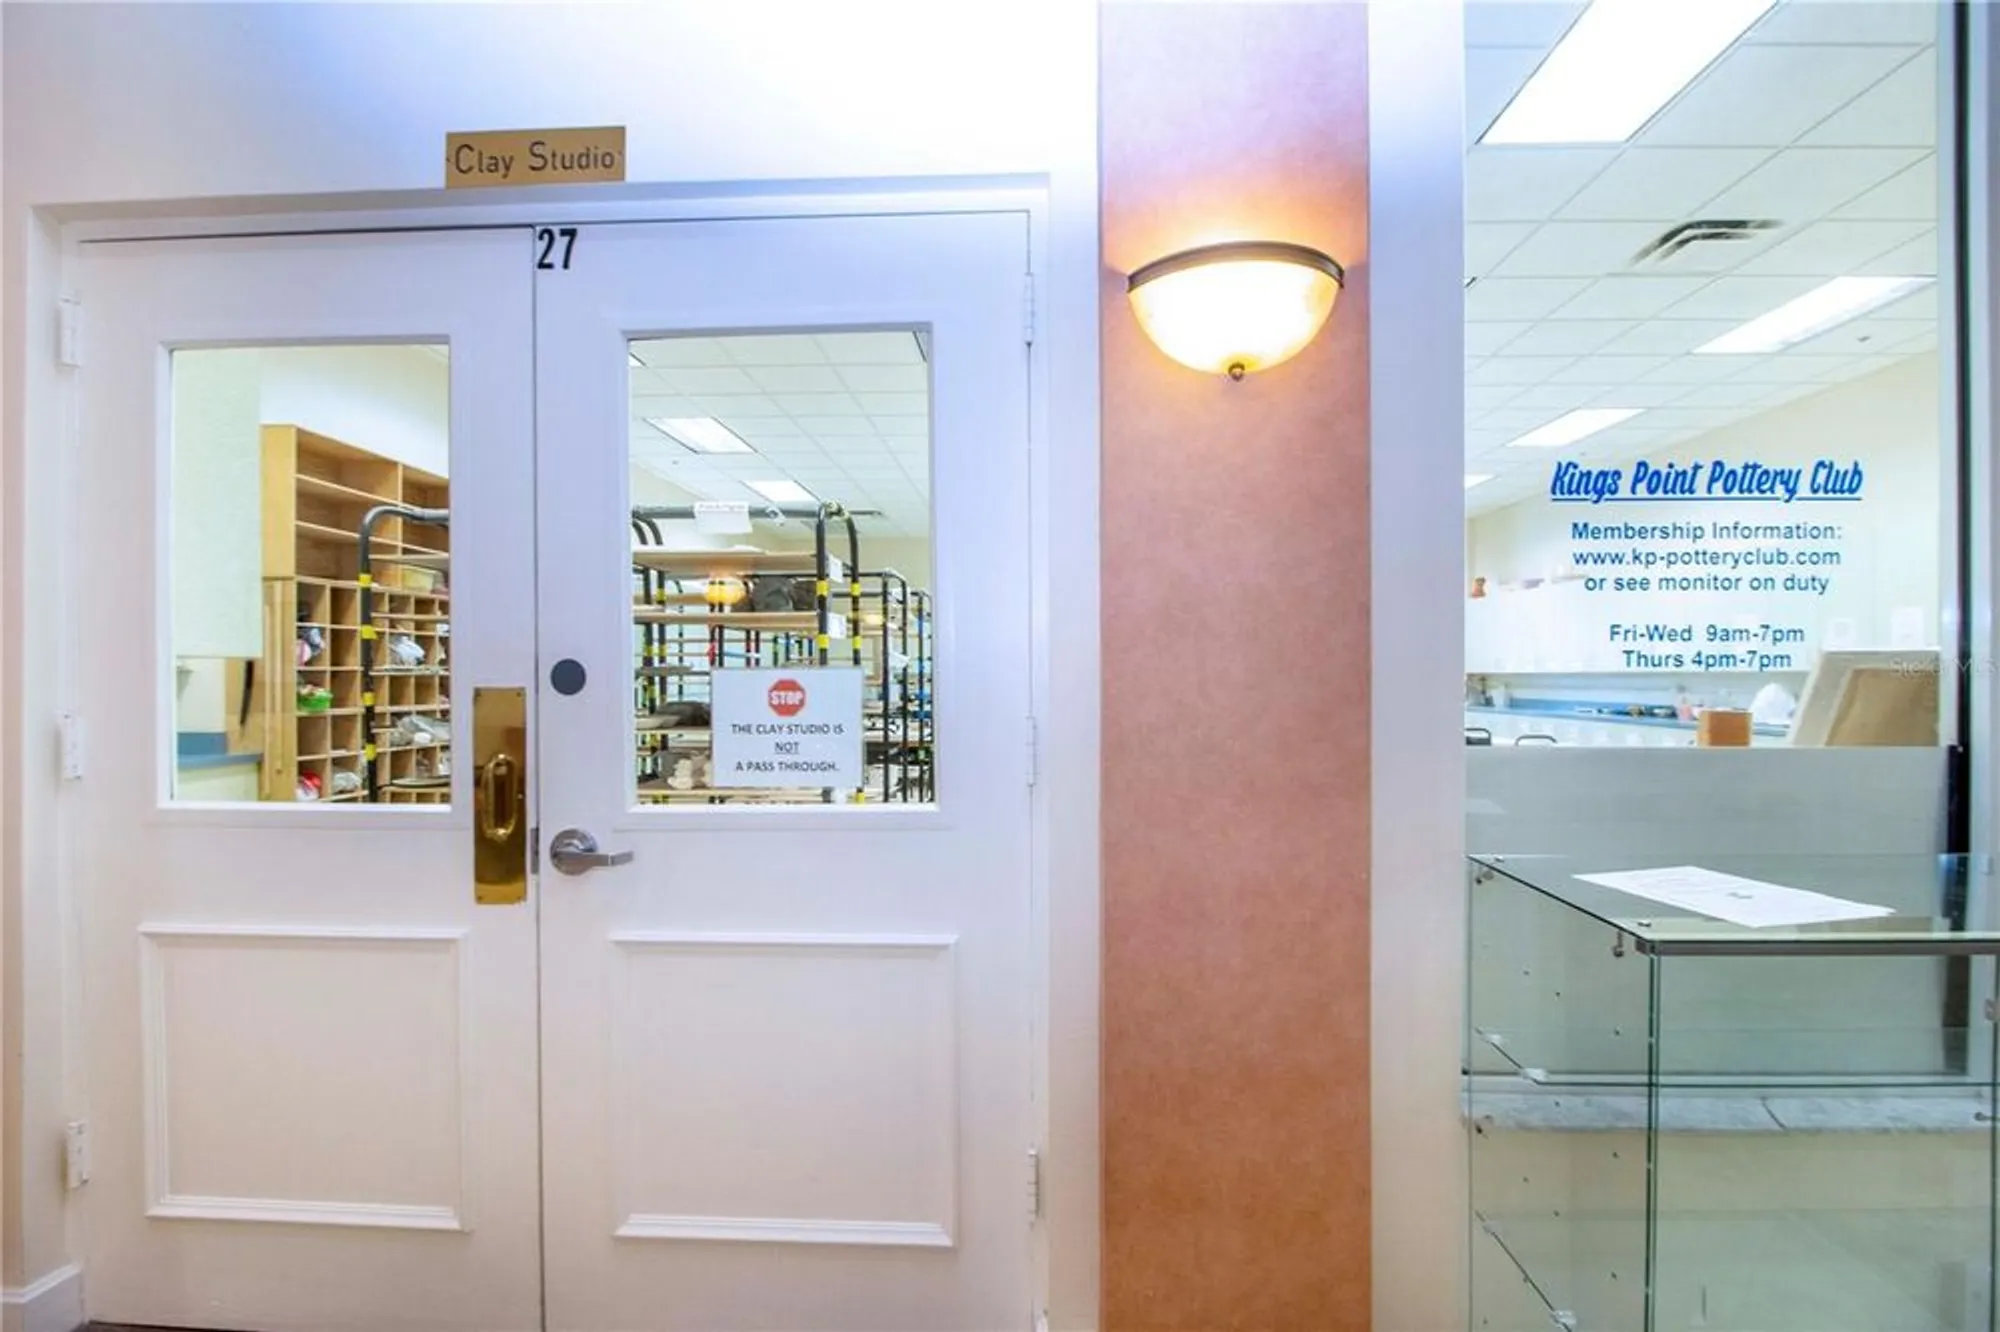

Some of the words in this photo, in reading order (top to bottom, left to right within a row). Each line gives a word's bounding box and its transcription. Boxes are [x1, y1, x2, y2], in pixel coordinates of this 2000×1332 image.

[455, 143, 514, 179] Clay
[528, 140, 615, 172] Studio
[536, 227, 577, 269] 27
[1550, 461, 1622, 504] Kings
[1631, 460, 1704, 495] Point
[1706, 460, 1802, 503] Pottery
[1810, 460, 1863, 495] Club
[1572, 521, 1705, 543] Membership
[1712, 521, 1842, 539] Information:
[1573, 548, 1841, 569] www.kp-potteryclub.com
[1584, 577, 1607, 591] or
[1614, 577, 1650, 591] see
[1658, 574, 1742, 591] monitor
[1750, 577, 1775, 591] on
[1783, 573, 1829, 595] duty
[1609, 624, 1693, 642] Fri-Wed
[1706, 624, 1805, 646] 9am-7pm
[1623, 650, 1684, 668] Thurs
[1691, 650, 1792, 671] 4pm-7pm
[770, 690, 804, 705] STOP
[731, 723, 753, 735] THE
[756, 723, 785, 735] CLAY
[787, 723, 831, 735] STUDIO
[774, 741, 801, 754] NOT
[735, 761, 744, 771] A
[746, 761, 774, 772] PASS
[778, 761, 840, 772] THROUGH.
